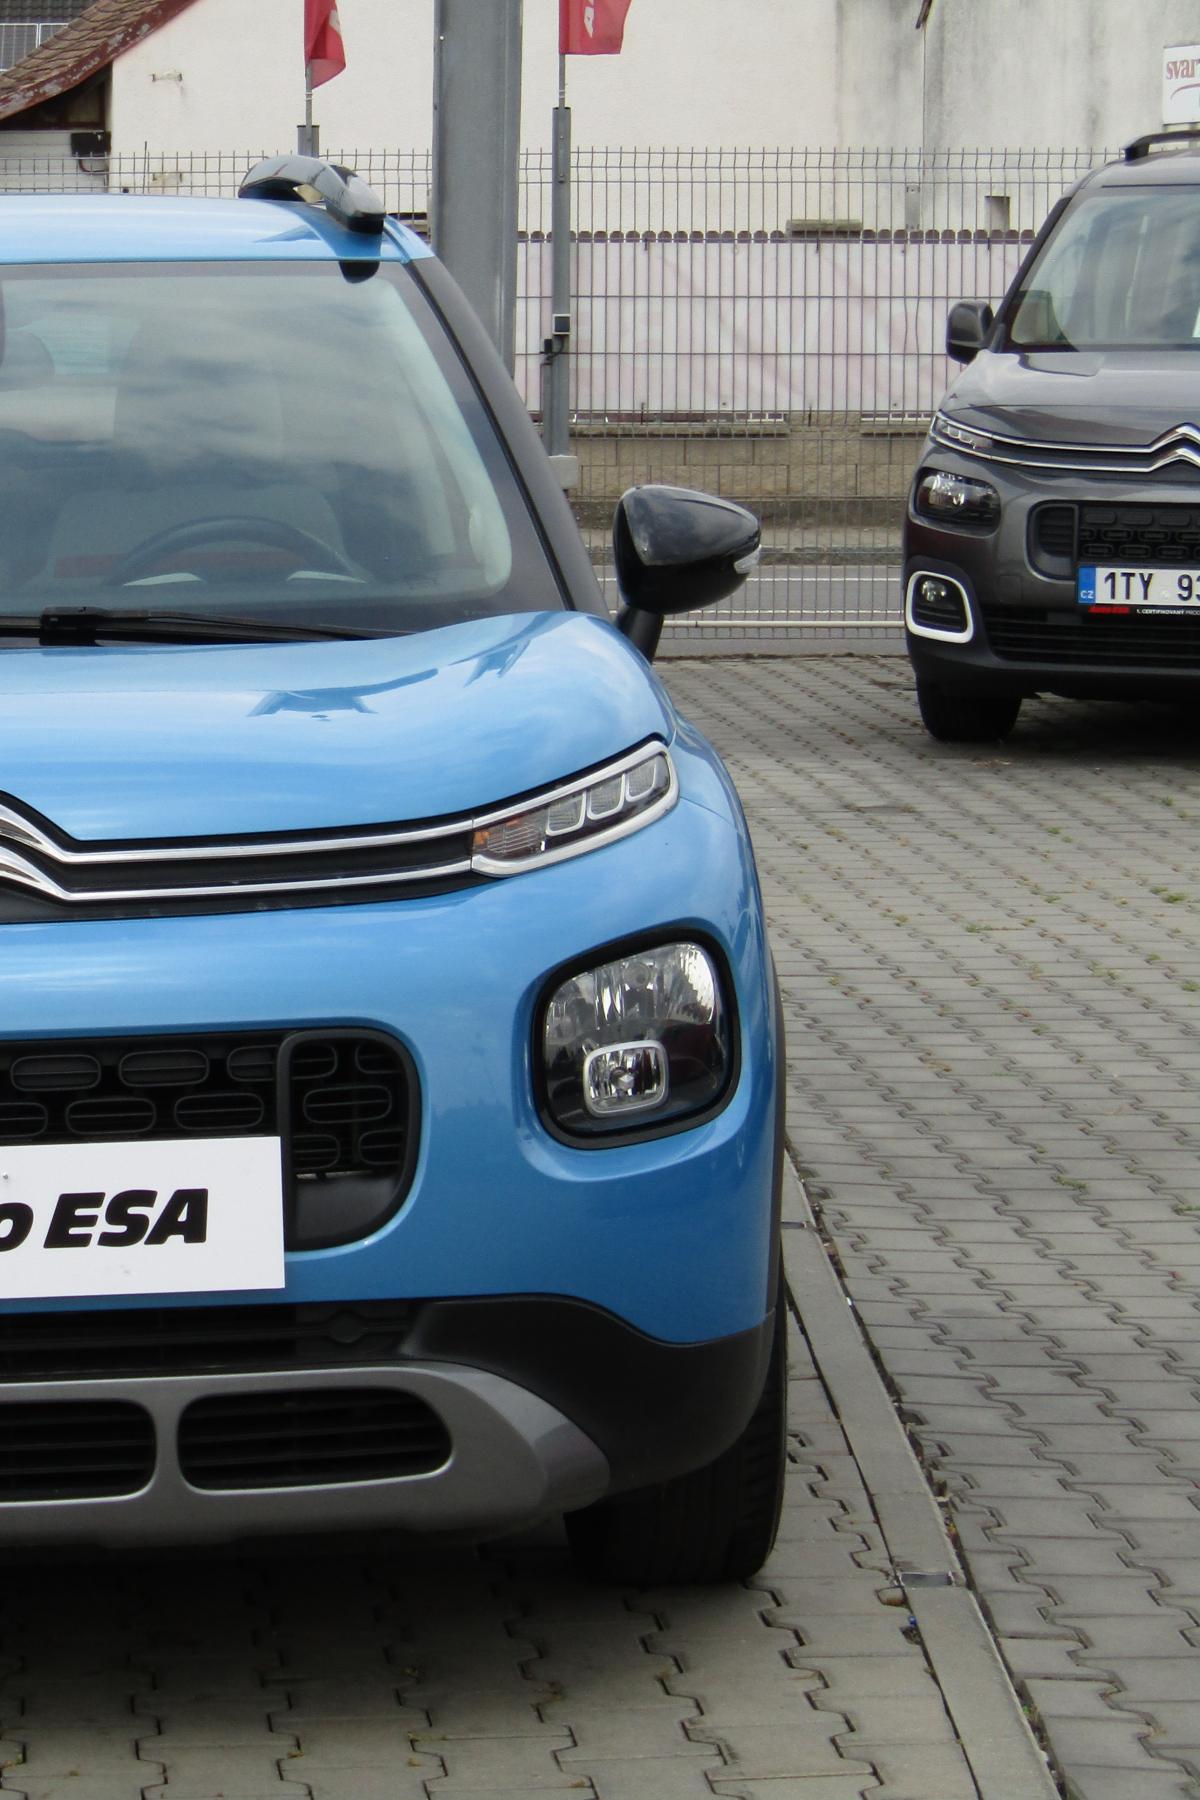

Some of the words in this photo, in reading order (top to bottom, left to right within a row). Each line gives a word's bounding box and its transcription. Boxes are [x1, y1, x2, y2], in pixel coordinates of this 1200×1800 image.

[1080, 590, 1094, 598] CZ
[1104, 571, 1153, 600] 1TY
[43, 1188, 208, 1249] ESA
